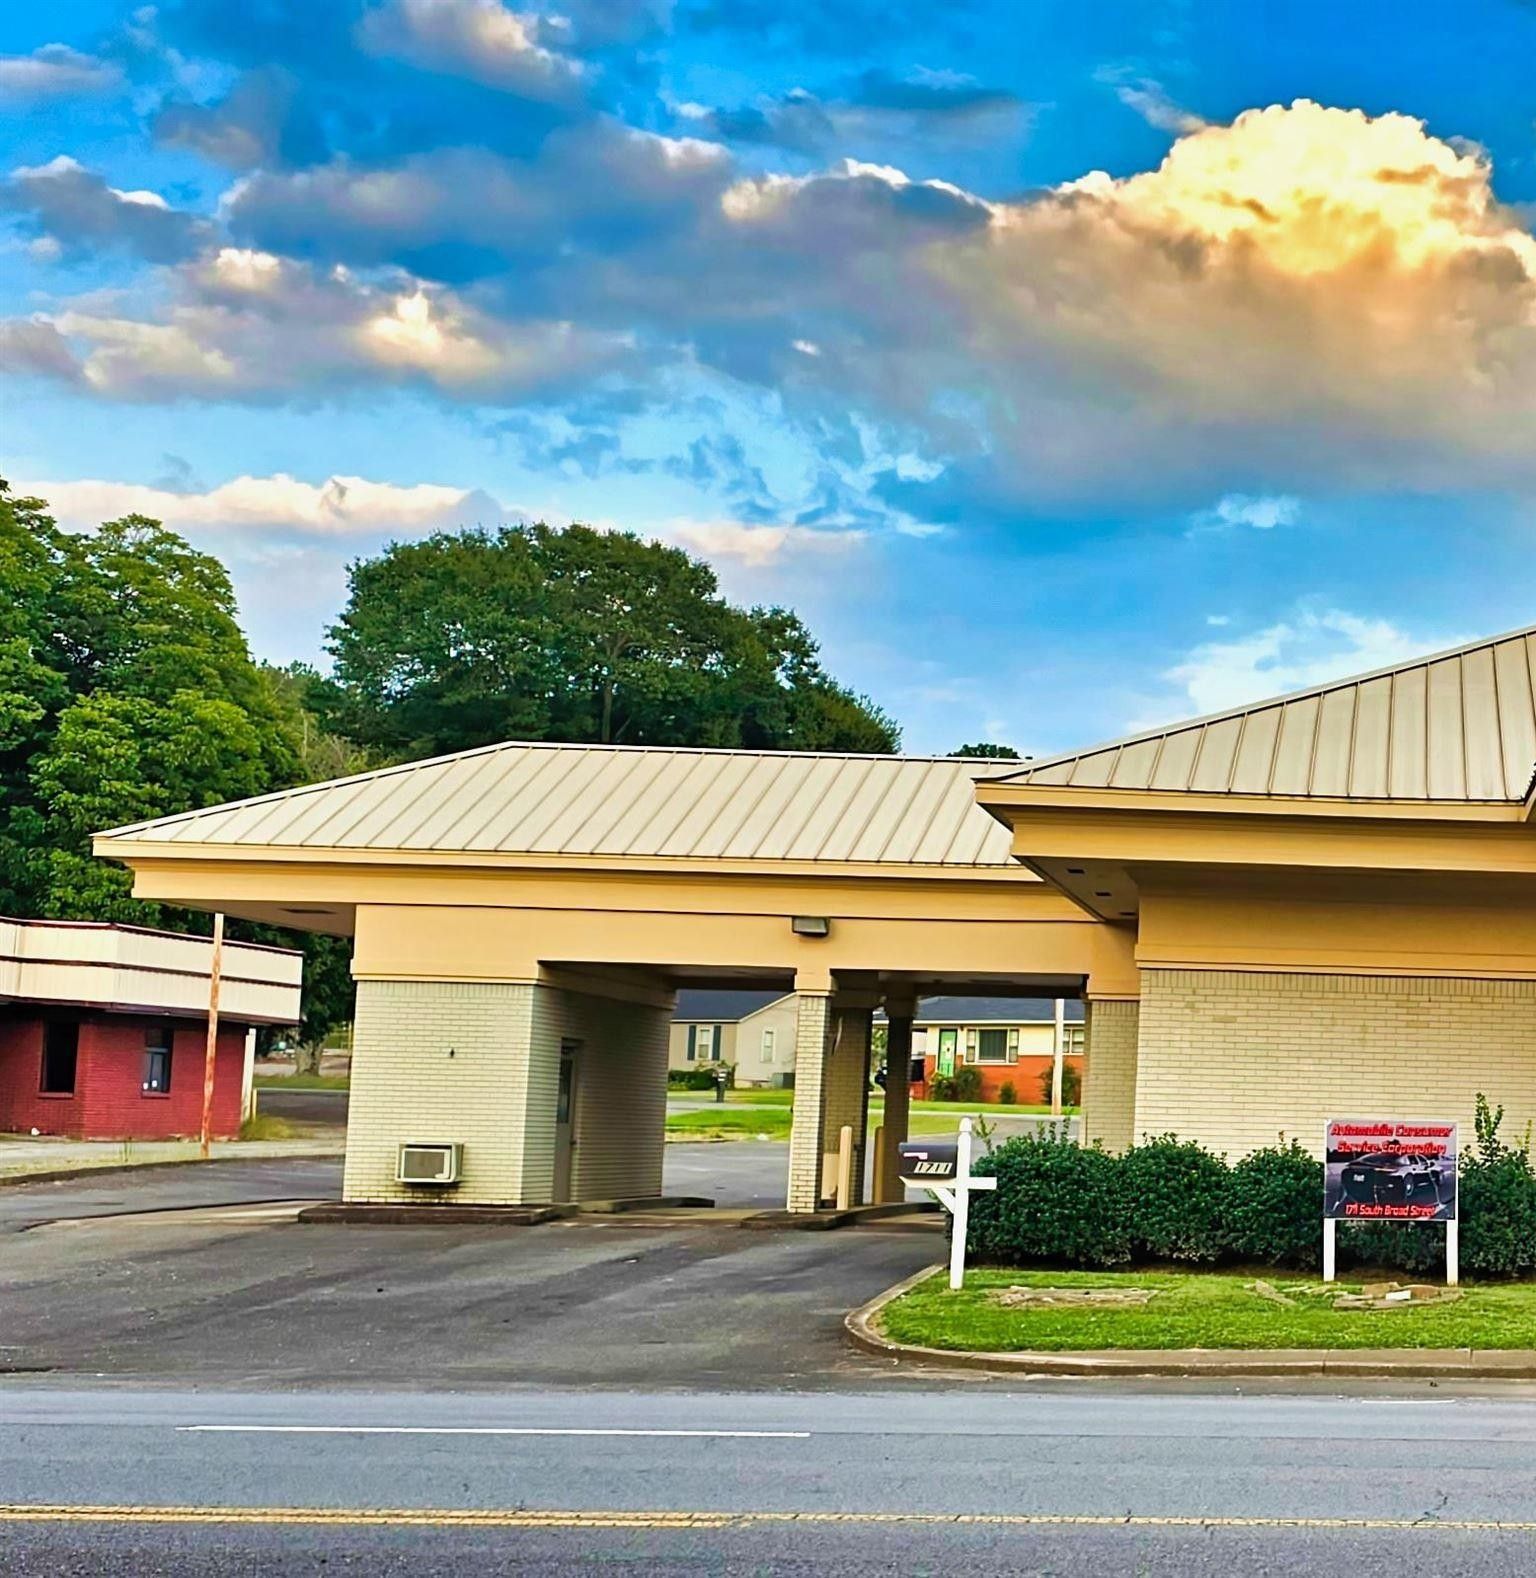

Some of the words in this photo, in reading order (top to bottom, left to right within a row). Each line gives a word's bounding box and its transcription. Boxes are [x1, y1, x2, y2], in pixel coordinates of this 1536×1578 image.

[1331, 1124, 1394, 1136] Automobile
[1337, 1140, 1380, 1153] Service
[1379, 1140, 1446, 1155] Corporation
[914, 1161, 953, 1175] 1711
[1359, 1204, 1383, 1216] South
[1384, 1205, 1410, 1216] Broad
[1410, 1206, 1437, 1217] Street
